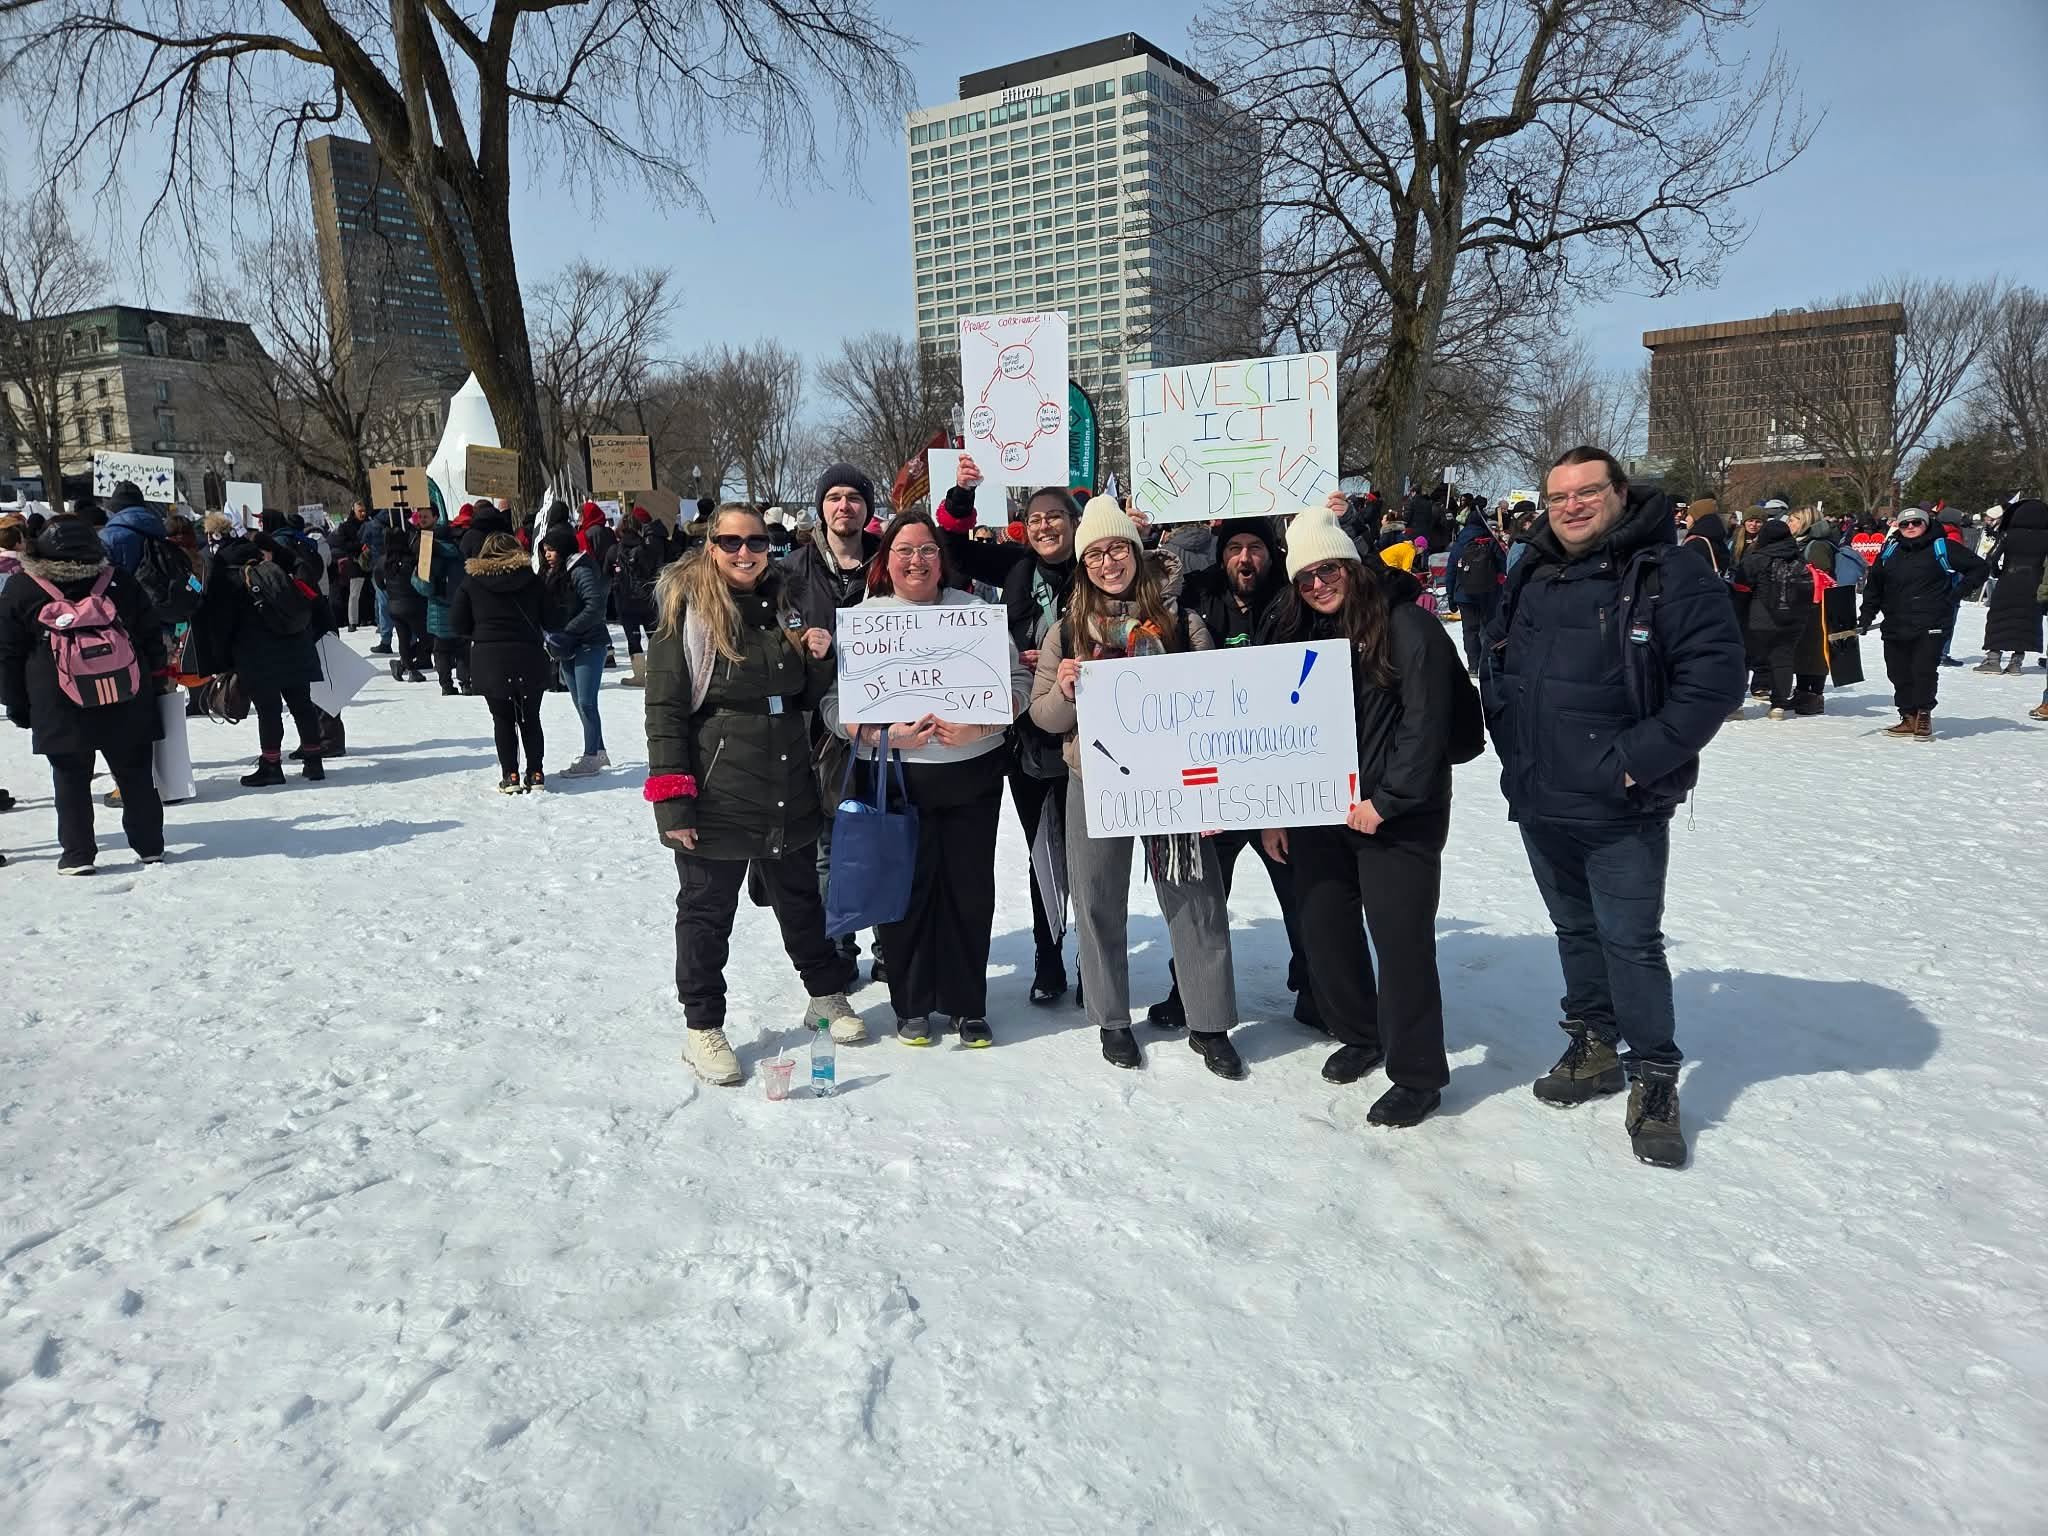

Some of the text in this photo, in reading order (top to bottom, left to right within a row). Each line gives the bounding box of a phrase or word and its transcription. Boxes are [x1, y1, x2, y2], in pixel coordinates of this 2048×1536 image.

[1000, 85, 1042, 106] Hilton
[1128, 355, 1330, 418] INVESTIR
[1193, 405, 1279, 442] ICI
[1209, 468, 1276, 515] DES
[938, 610, 988, 627] MAIS
[864, 668, 943, 701] DE L'AIR
[1115, 670, 1248, 736] Coupez le
[1100, 788, 1183, 832] COUPER
